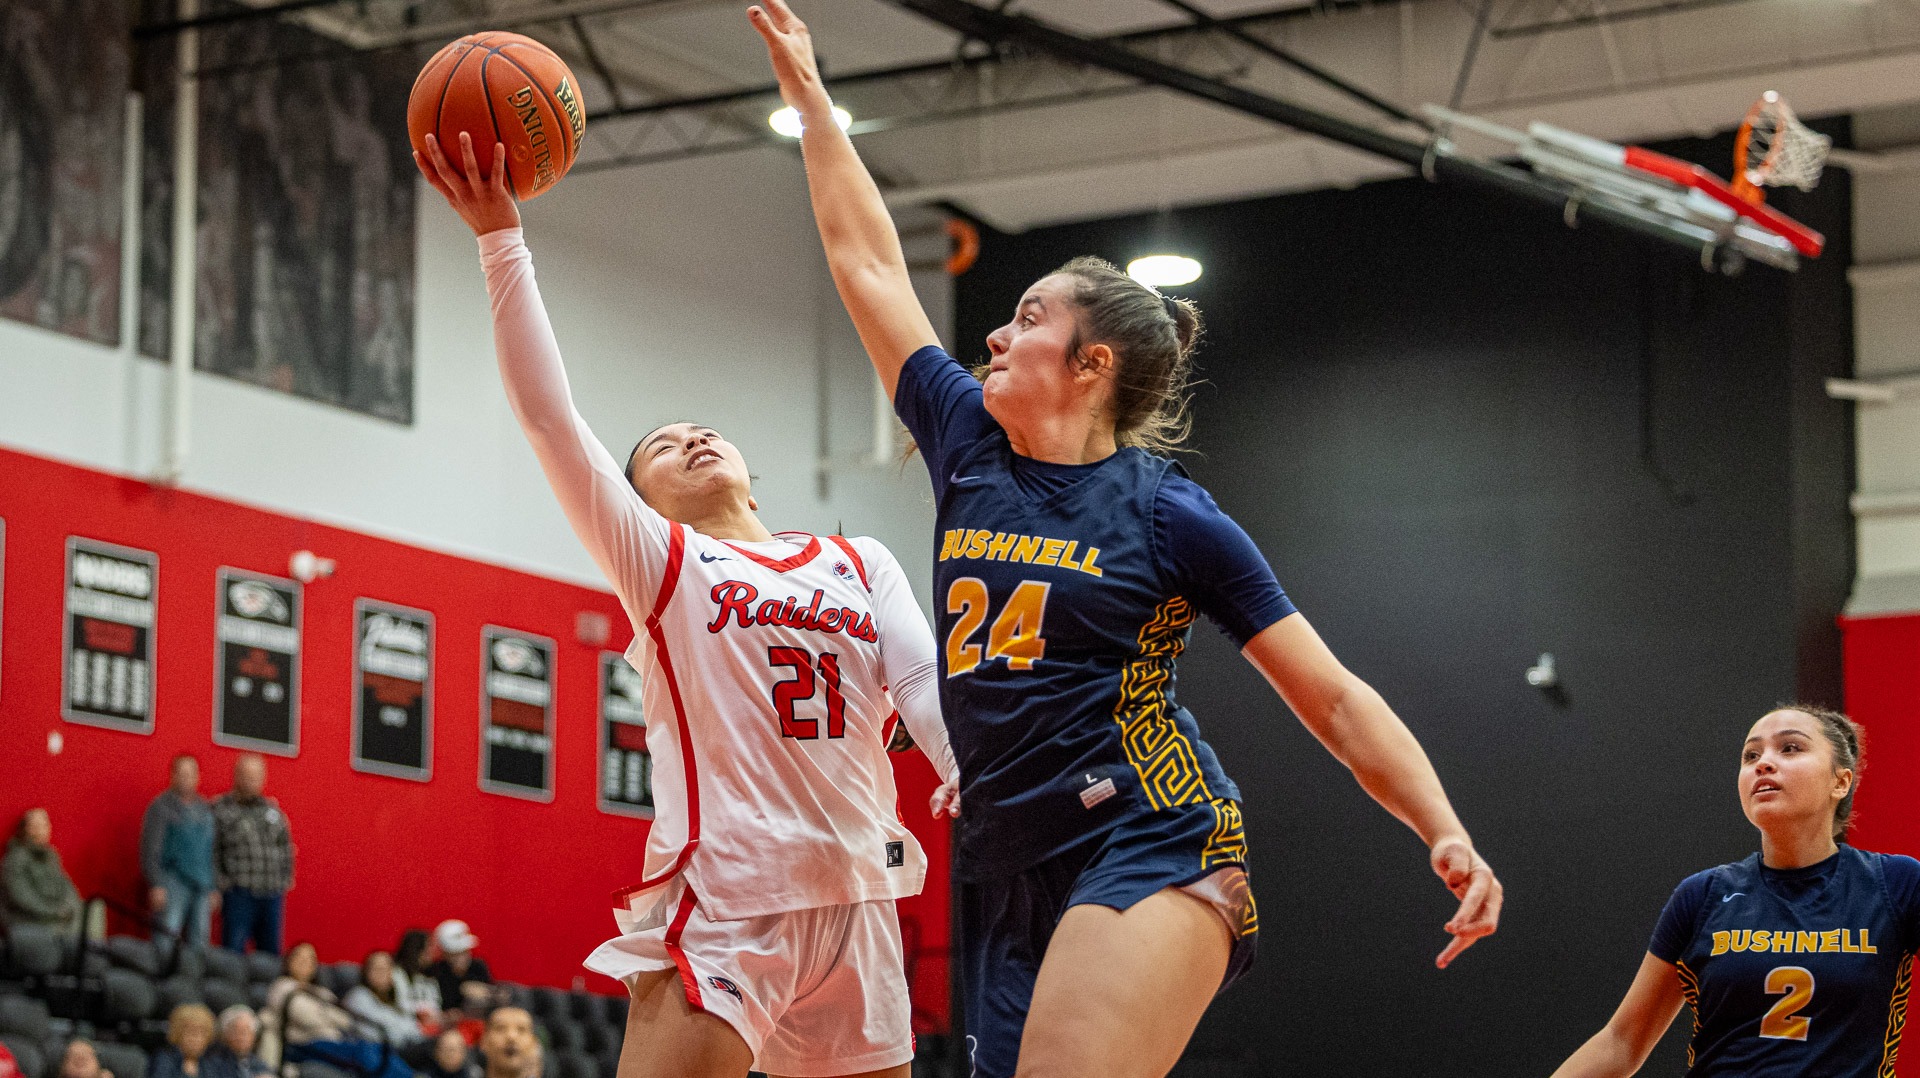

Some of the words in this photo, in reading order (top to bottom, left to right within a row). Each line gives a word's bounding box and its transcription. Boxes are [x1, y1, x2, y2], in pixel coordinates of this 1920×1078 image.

[939, 528, 1103, 577] BUSHNELL
[707, 579, 878, 643] Raiders
[946, 577, 1051, 679] 24
[768, 646, 846, 739] 21
[1710, 928, 1878, 956] BUSHNELL
[1759, 966, 1815, 1041] 2
